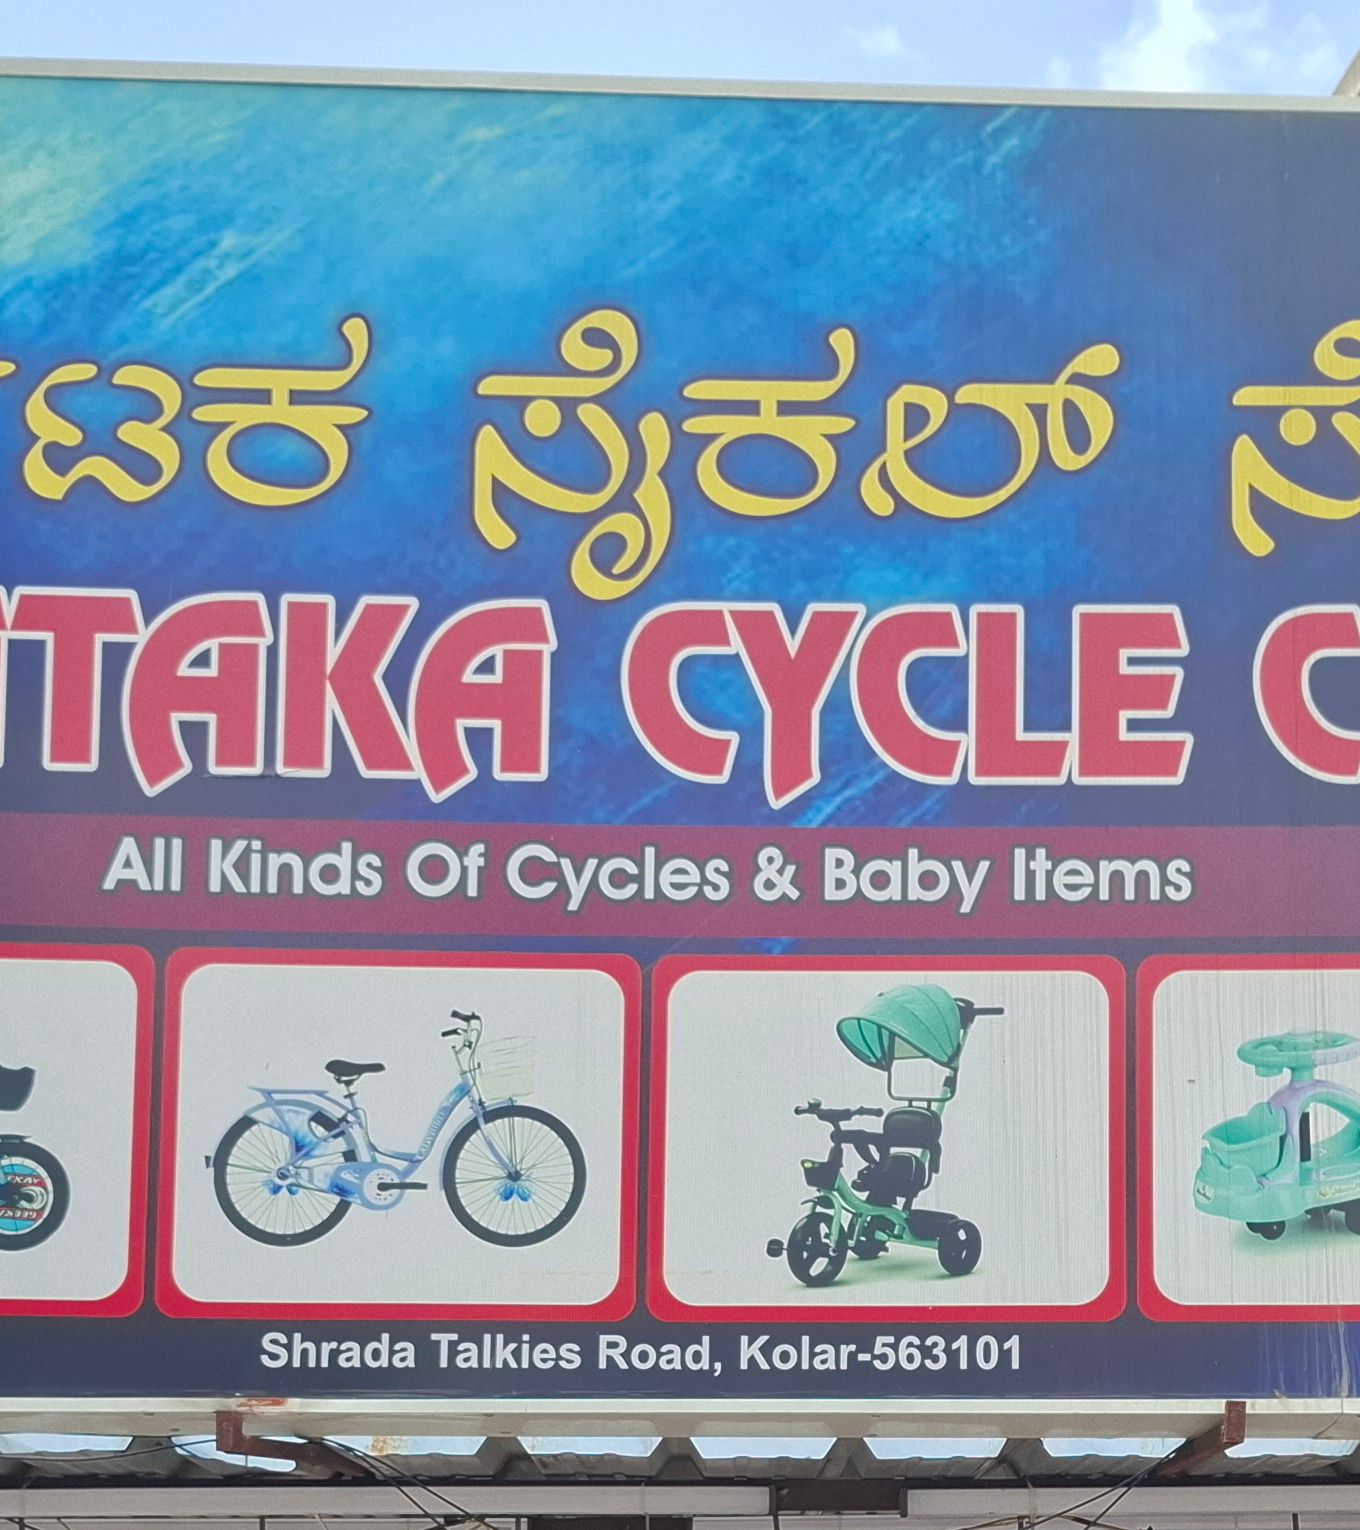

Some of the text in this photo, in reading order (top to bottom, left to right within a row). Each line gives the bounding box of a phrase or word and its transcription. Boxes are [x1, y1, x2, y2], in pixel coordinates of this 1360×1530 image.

[475, 310, 1118, 600] ಸೈಕಲ್
[620, 601, 1195, 811] CYCLE
[102, 836, 1192, 915] All Kinds Of Cycles & Baby Items
[259, 1331, 1021, 1378] Shrada Talkies Road, Kolar-563101
